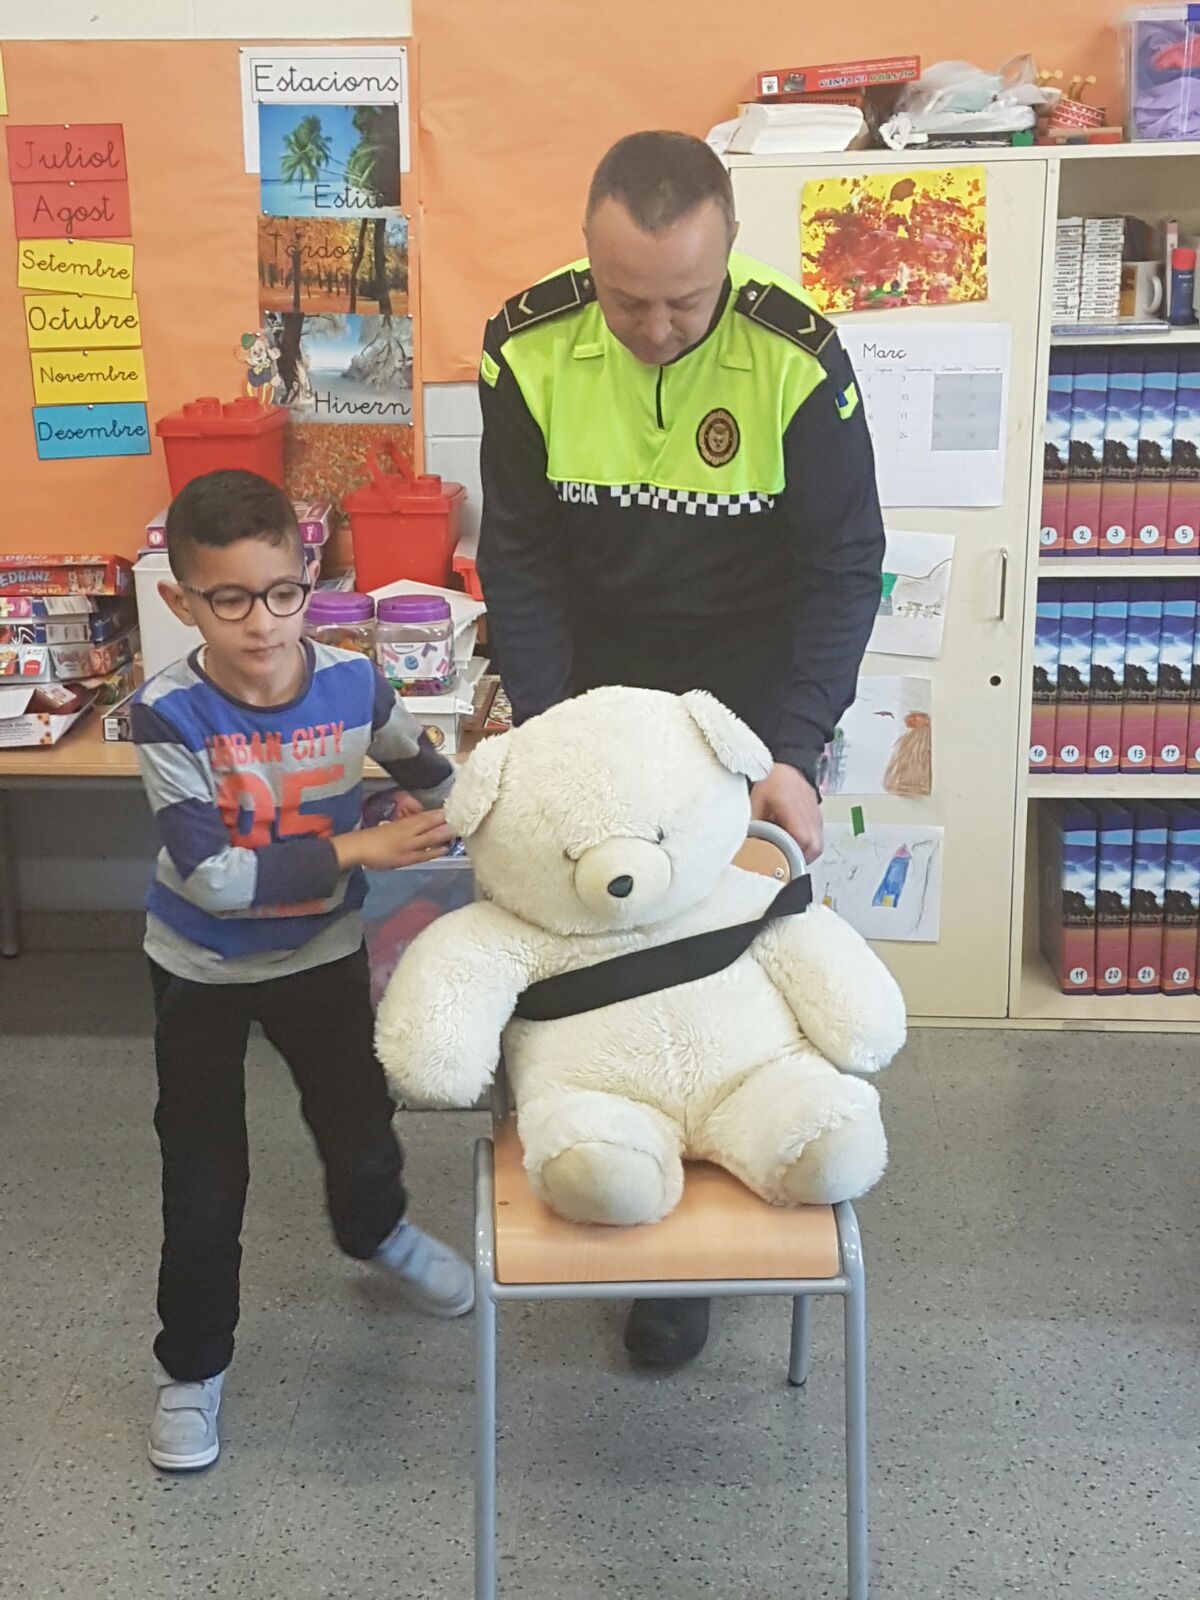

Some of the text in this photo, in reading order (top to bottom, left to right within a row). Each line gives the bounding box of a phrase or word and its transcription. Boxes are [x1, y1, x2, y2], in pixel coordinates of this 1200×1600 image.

[255, 65, 399, 92] Estacions
[16, 141, 120, 169] Juliol
[314, 184, 384, 209] Estiu
[33, 195, 115, 234] Agost
[268, 233, 360, 259] Tardor
[22, 250, 130, 280] Setembre
[28, 306, 138, 331] Octubre
[40, 366, 139, 383] Novembre
[314, 391, 413, 415] Hivern
[38, 420, 146, 441] Desembre
[1079, 530, 1086, 540] 2
[1112, 528, 1119, 538] 3
[1146, 528, 1153, 539] 4
[1181, 529, 1188, 539] 5
[292, 721, 345, 760] CITY
[1033, 749, 1043, 758] 10
[1064, 748, 1075, 757] 11
[1099, 749, 1110, 759] 12
[1133, 749, 1144, 759] 13
[1108, 970, 1119, 979] 20
[1141, 970, 1151, 979] 21
[1176, 971, 1187, 981] 22
